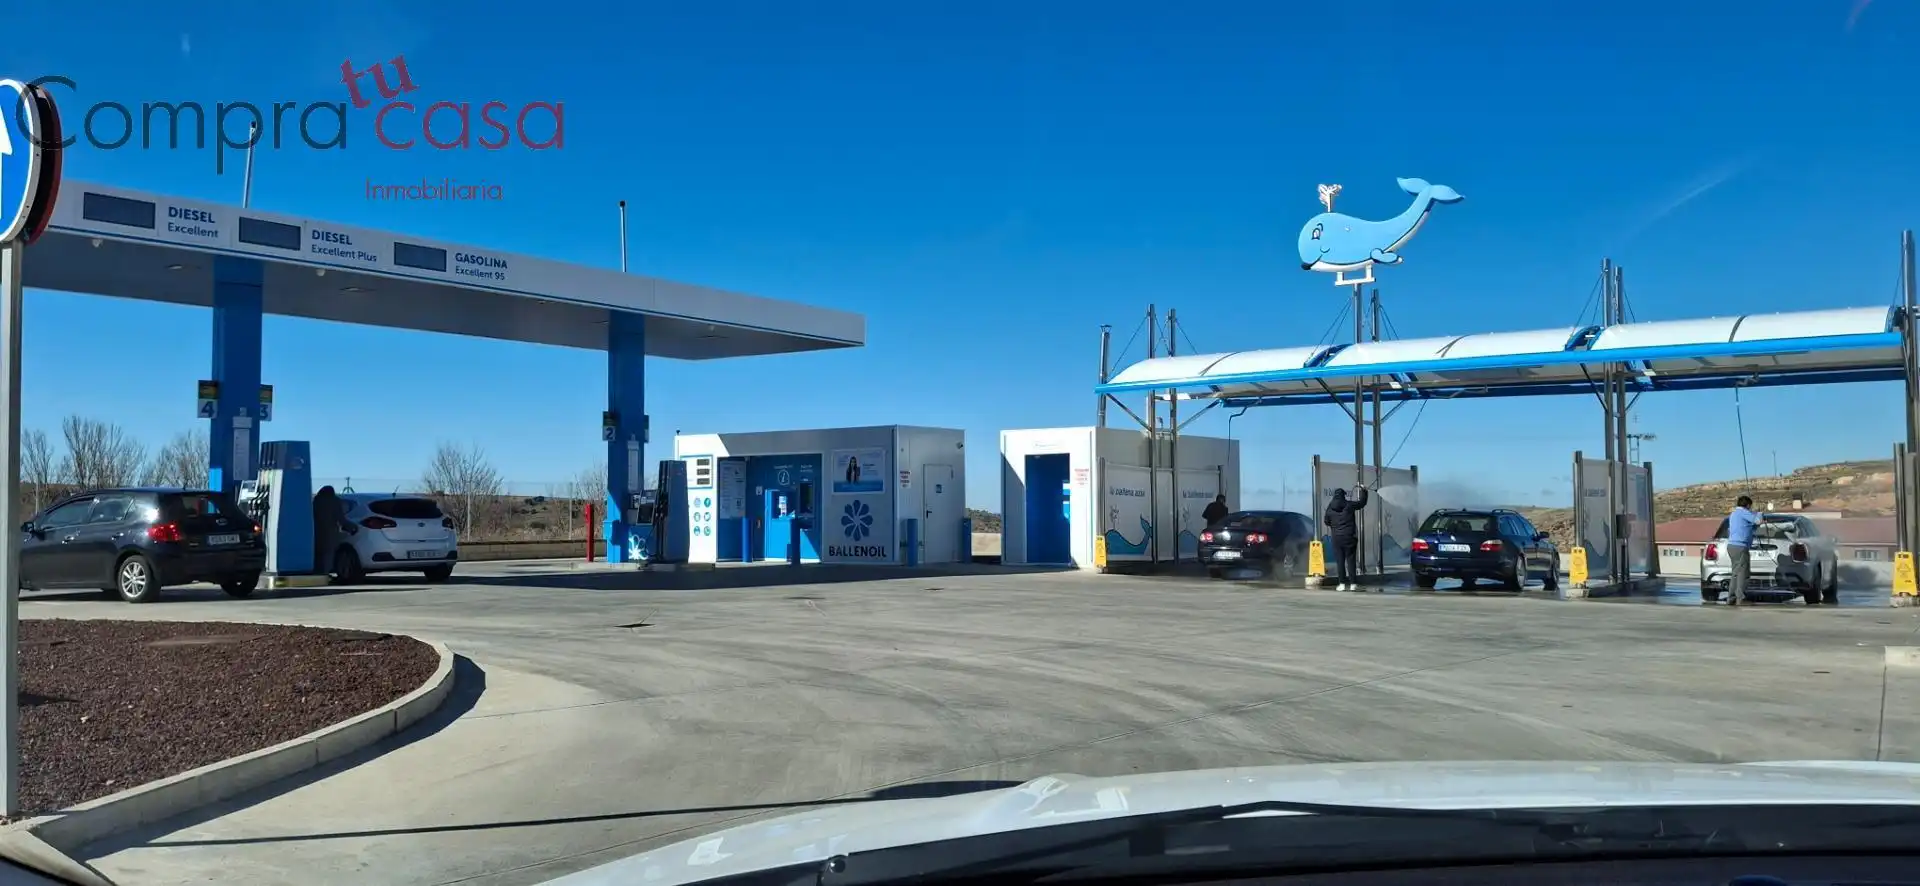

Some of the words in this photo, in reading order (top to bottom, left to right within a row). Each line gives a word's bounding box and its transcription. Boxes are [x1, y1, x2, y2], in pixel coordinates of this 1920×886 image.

[168, 206, 216, 224] DIESEL
[167, 222, 219, 239] Excellent
[311, 229, 353, 246] DIESEL
[311, 244, 356, 260] Excellent
[358, 251, 377, 263] Plus
[455, 252, 508, 270] GASOLINA
[455, 265, 493, 279] Excellent
[494, 271, 506, 281] 95
[201, 401, 215, 418] 4
[606, 427, 615, 440] 2
